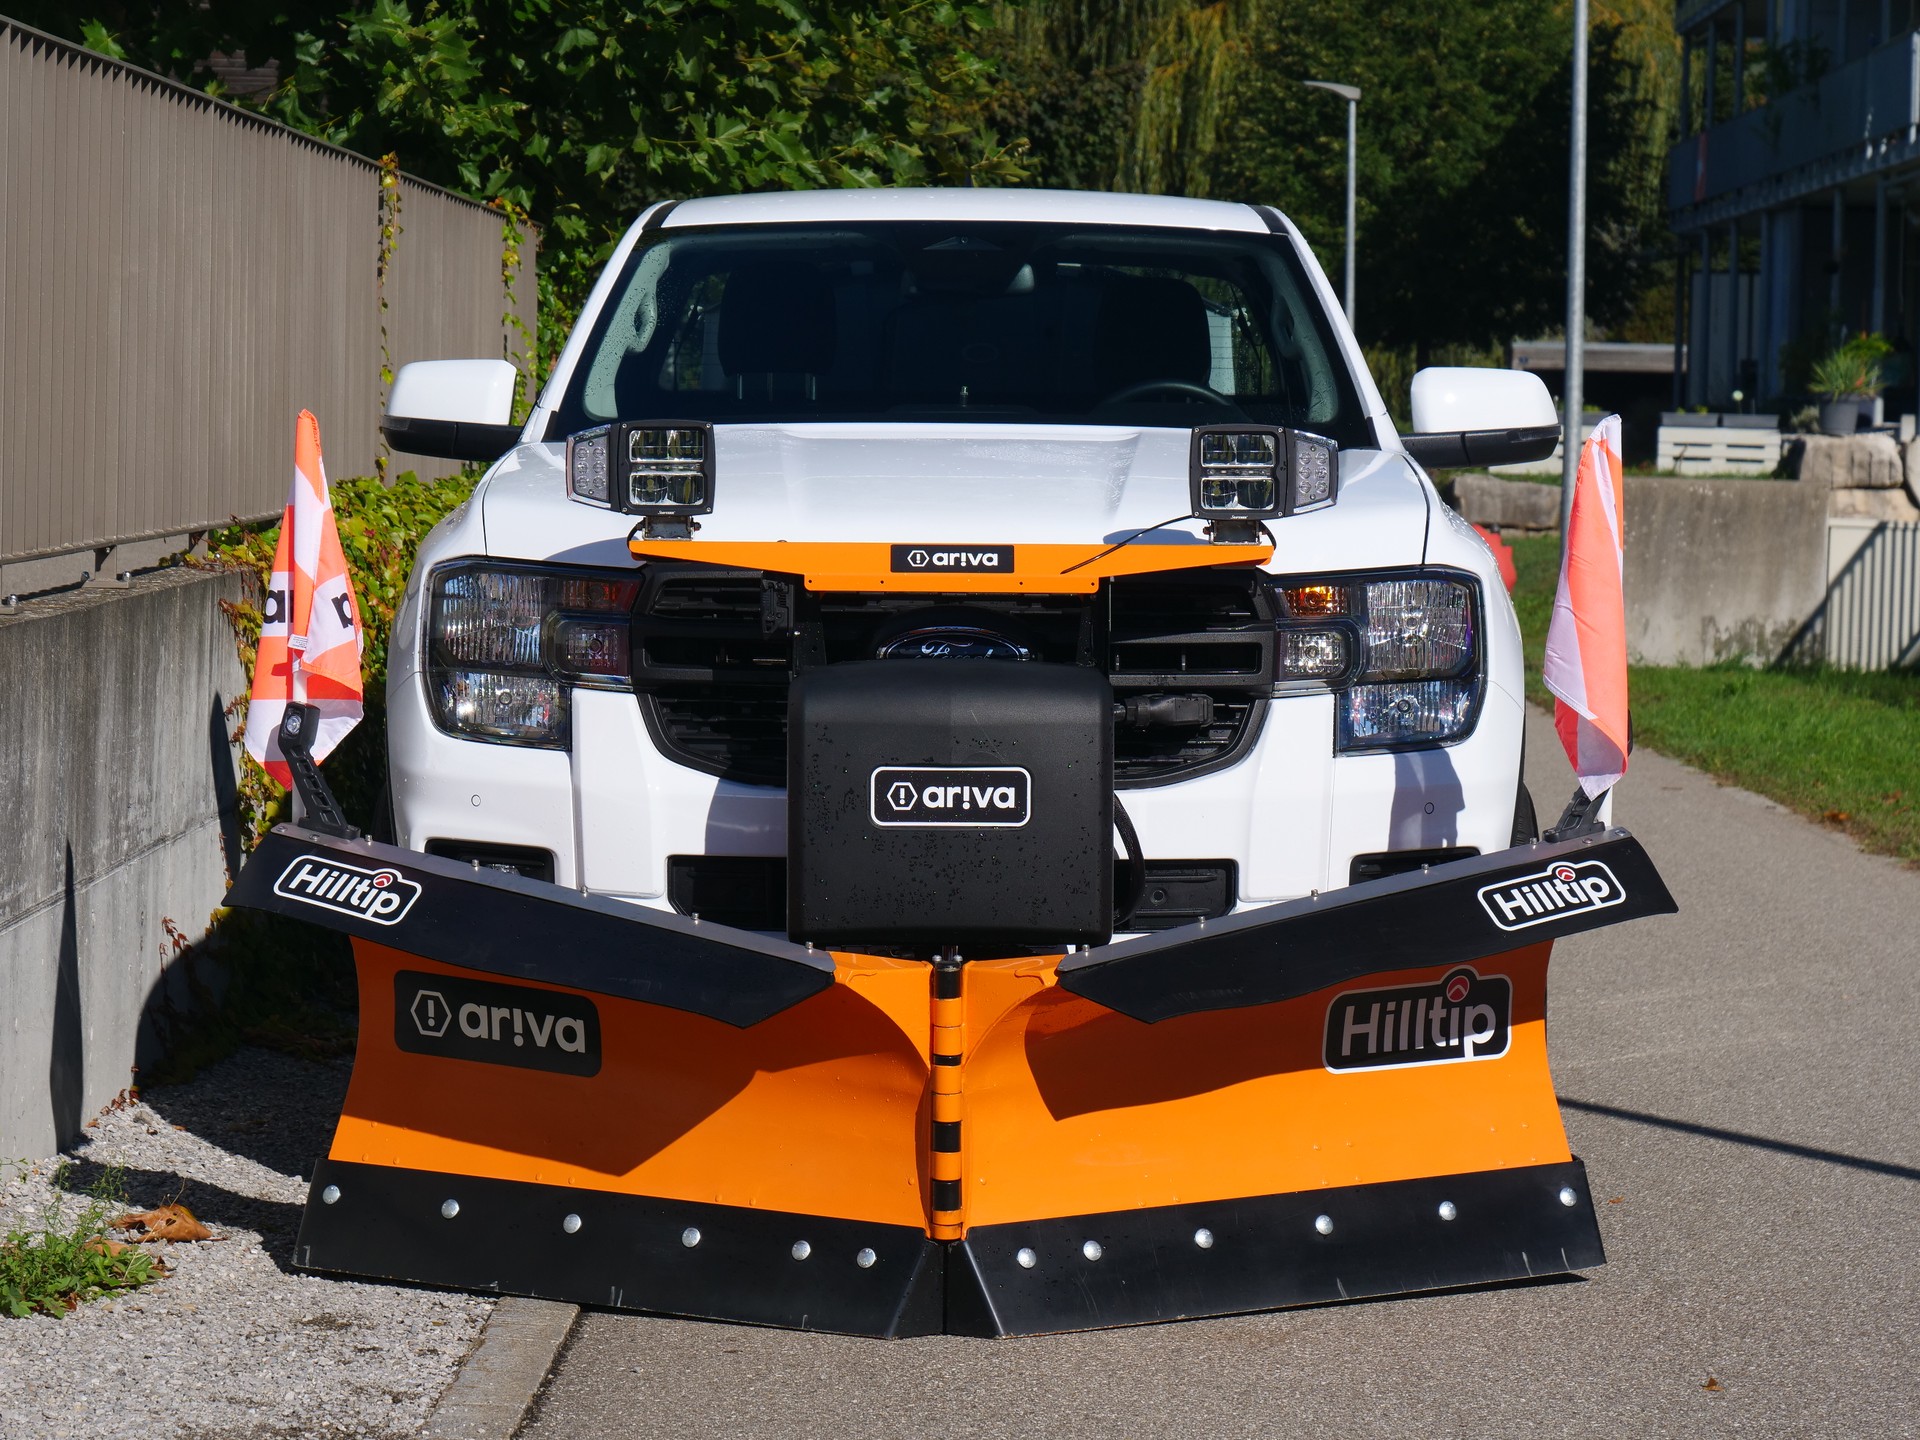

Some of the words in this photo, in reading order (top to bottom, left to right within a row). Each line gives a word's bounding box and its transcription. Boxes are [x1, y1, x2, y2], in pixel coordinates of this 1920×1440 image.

[288, 864, 401, 917] Hilltip
[1492, 866, 1610, 921] Hilltip
[1341, 975, 1497, 1058] Hilltip
